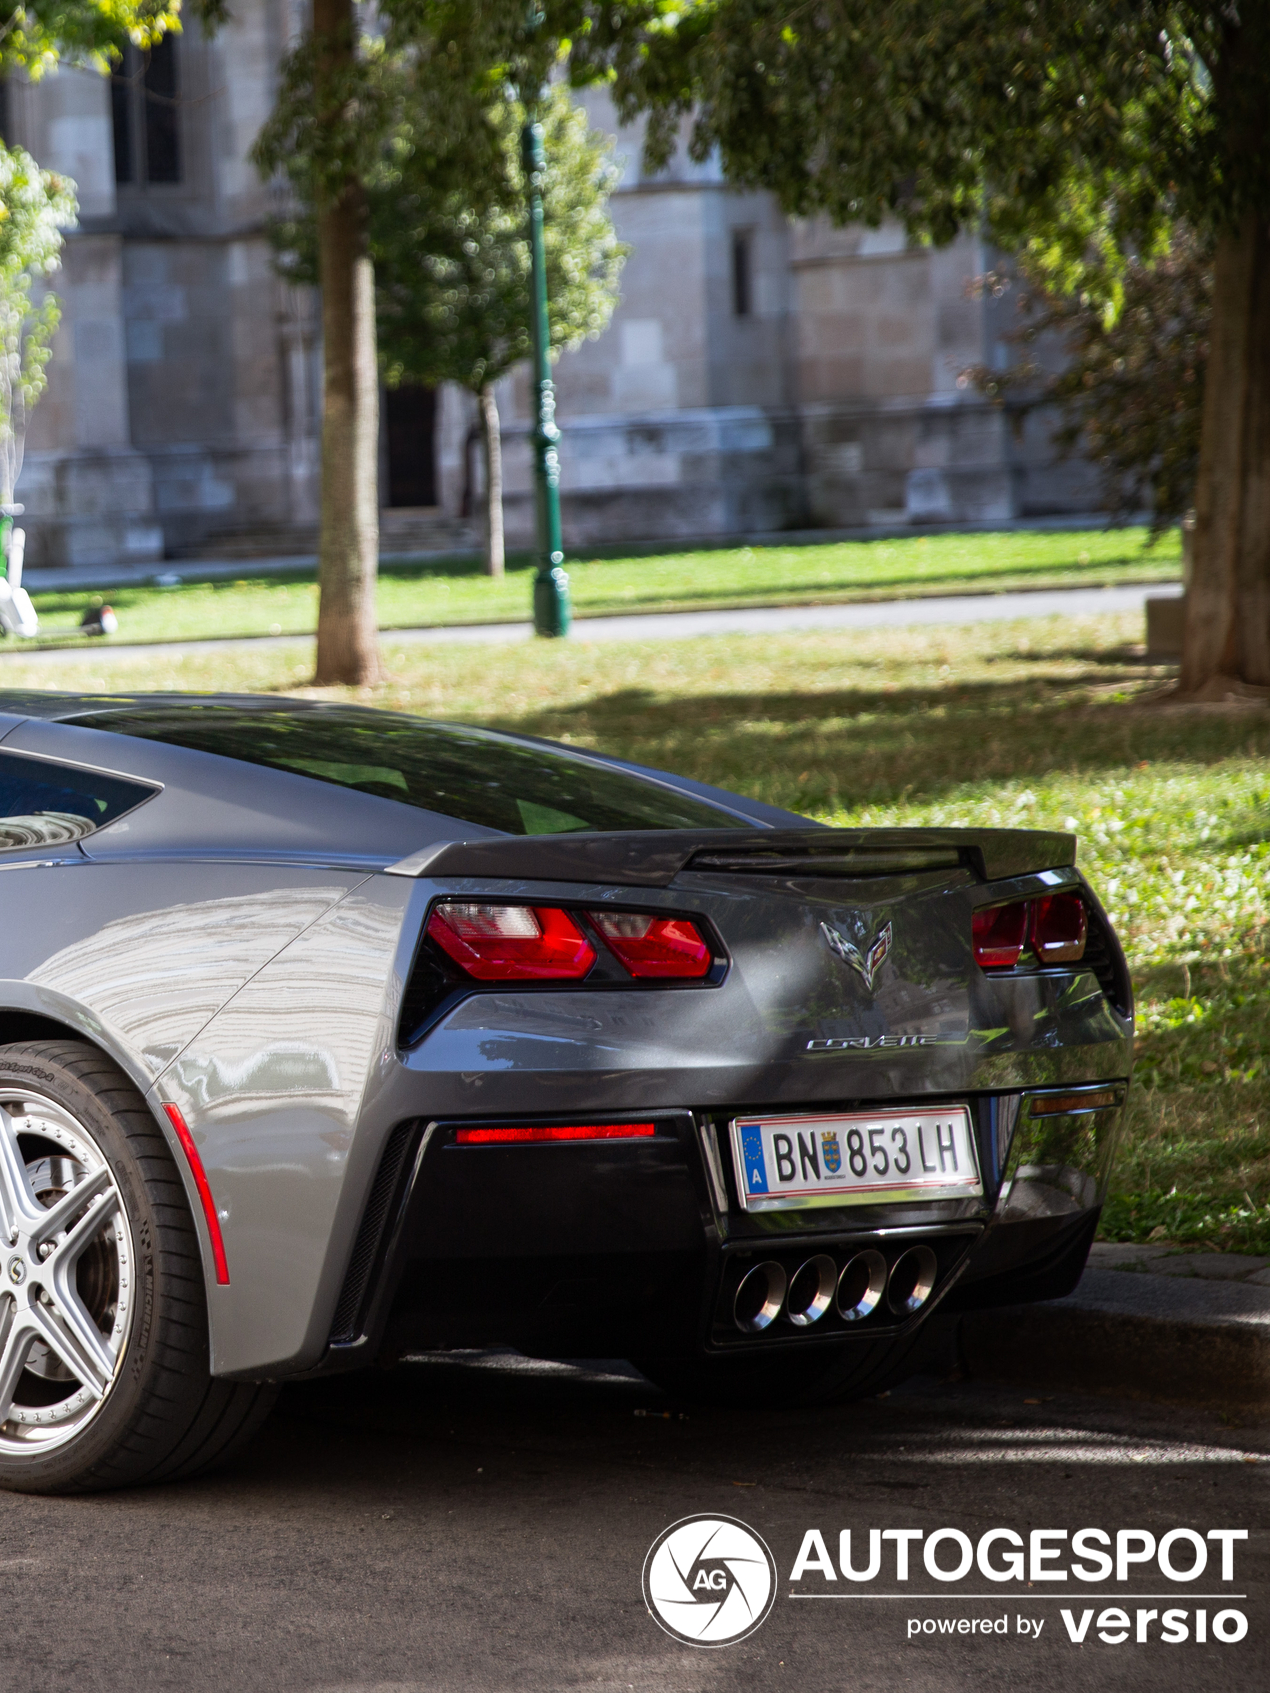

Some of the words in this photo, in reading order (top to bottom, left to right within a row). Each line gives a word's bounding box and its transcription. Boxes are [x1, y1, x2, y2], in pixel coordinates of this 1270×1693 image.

[806, 1034, 937, 1050] CORVETTE
[773, 1130, 821, 1182] BN
[846, 1125, 911, 1177] 853
[915, 1121, 959, 1173] LH
[751, 1168, 762, 1184] A
[139, 1275, 155, 1349] MICHELIN
